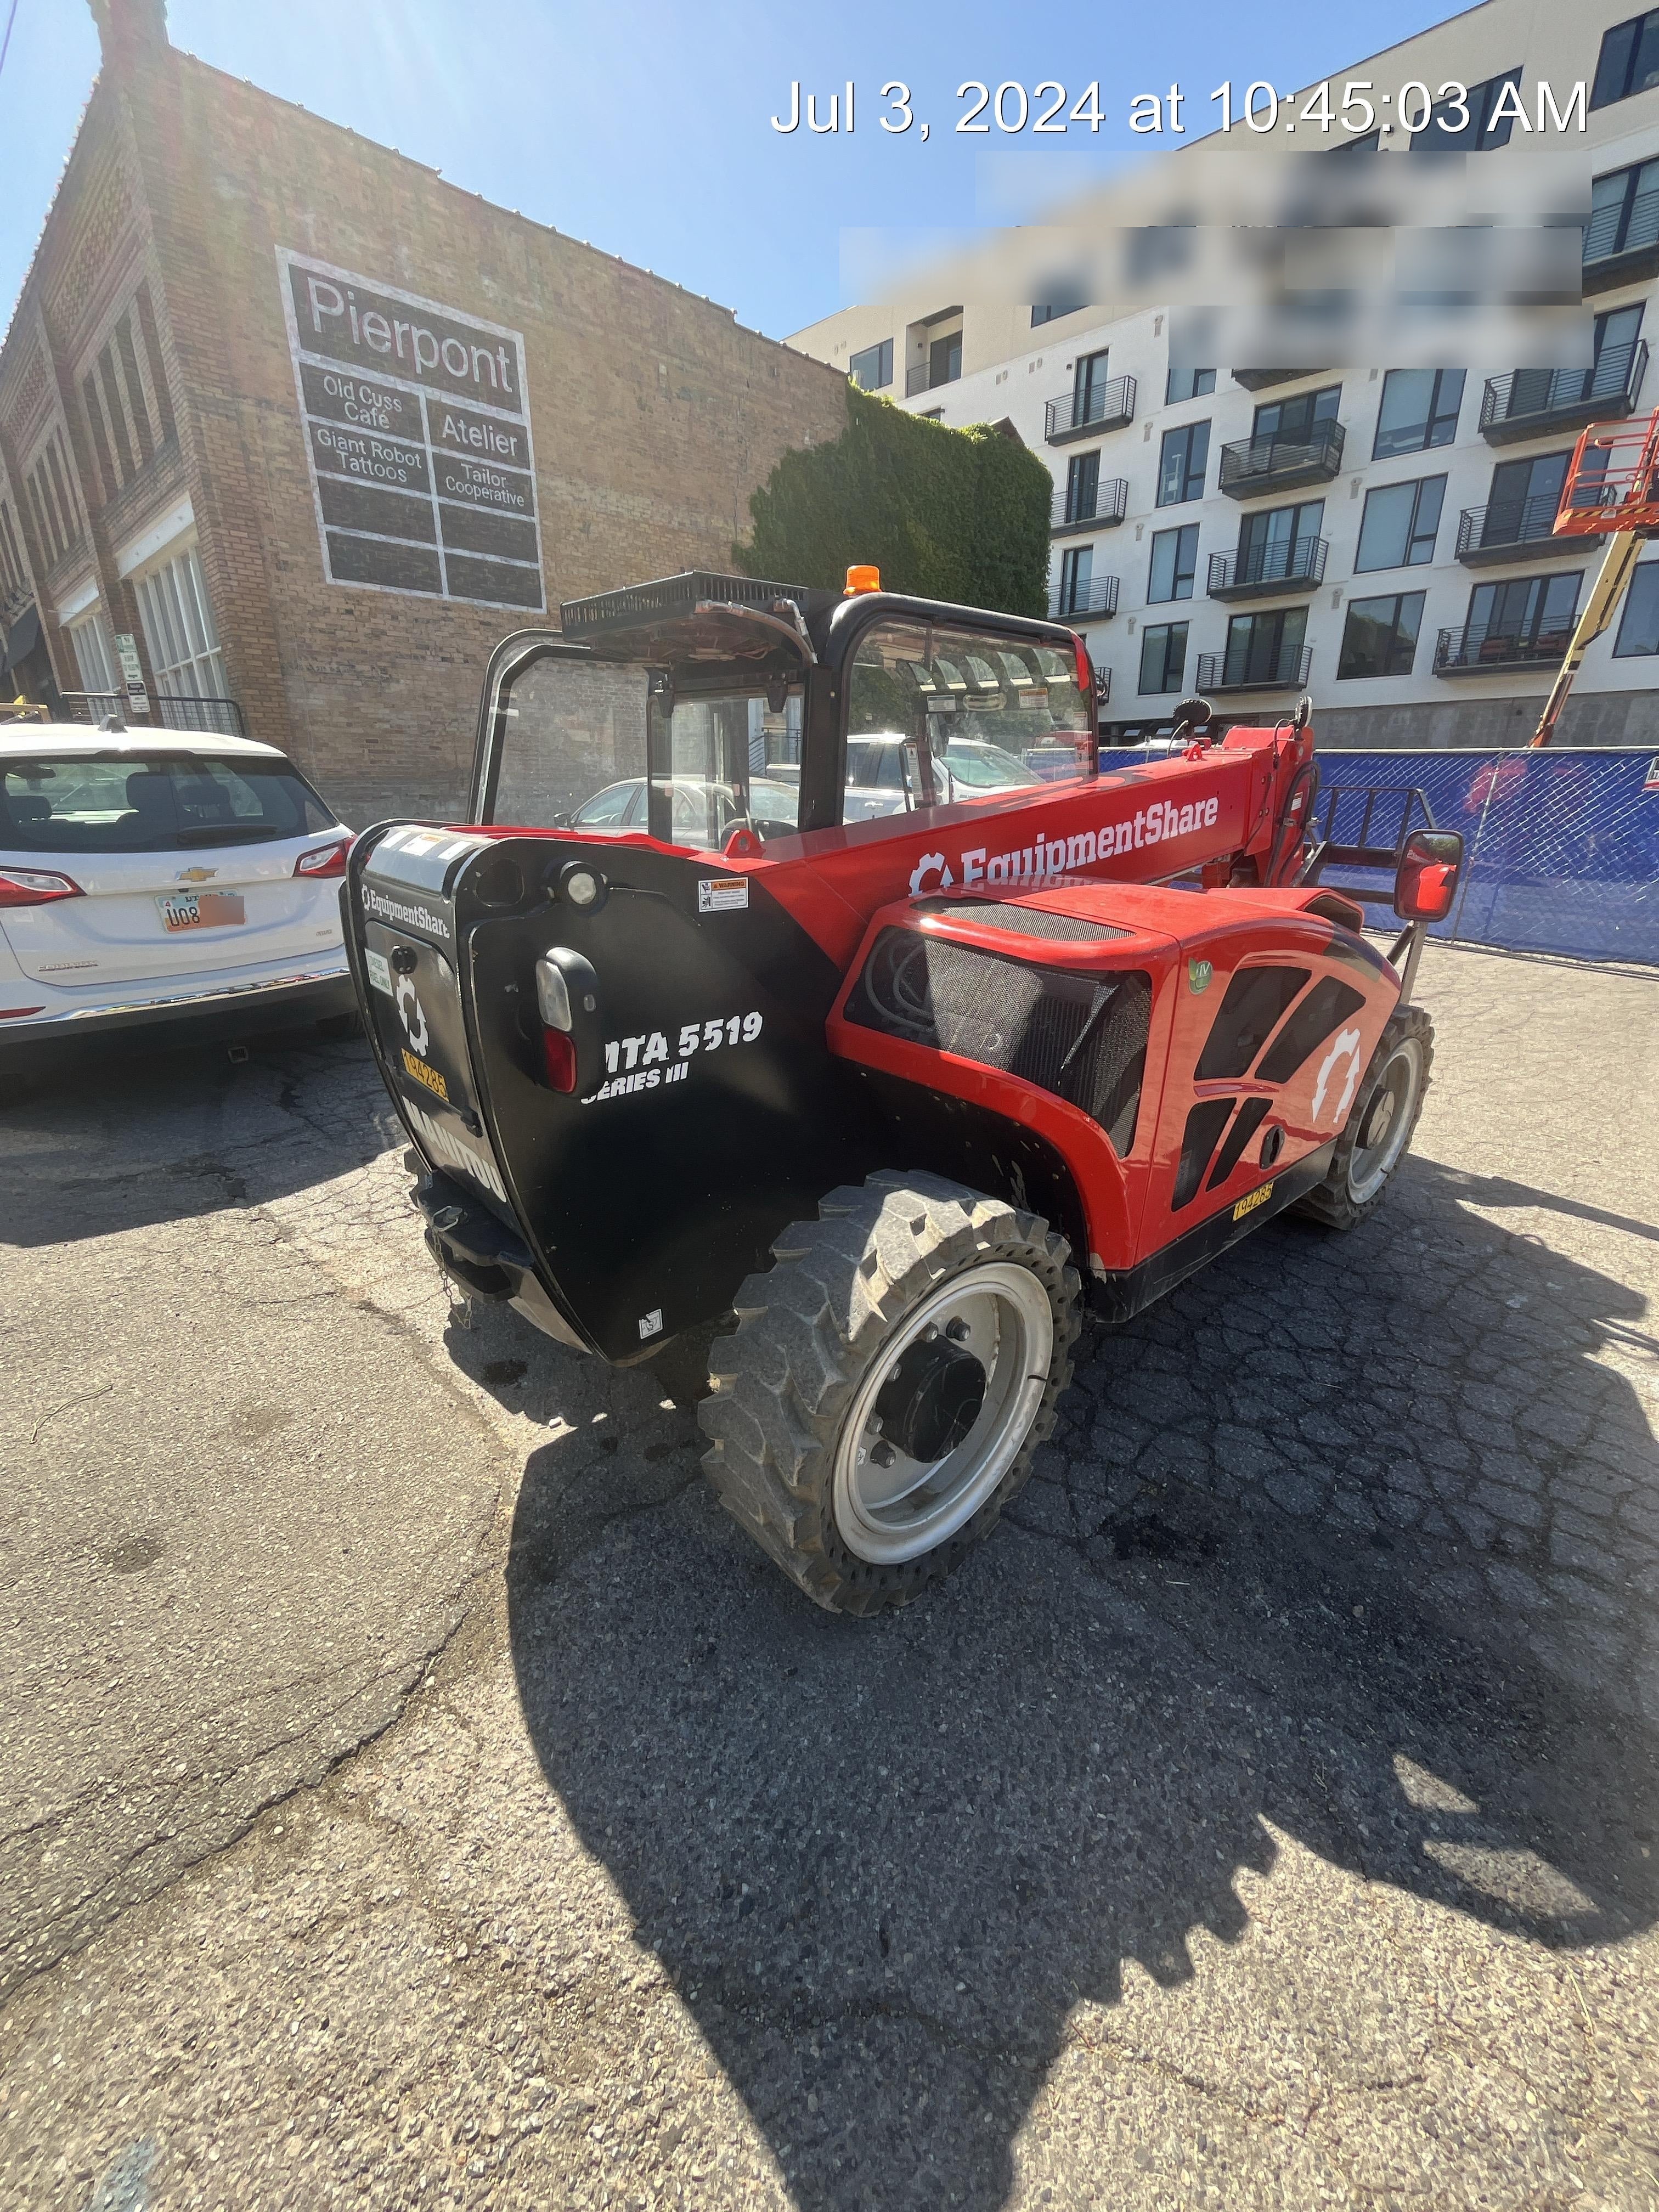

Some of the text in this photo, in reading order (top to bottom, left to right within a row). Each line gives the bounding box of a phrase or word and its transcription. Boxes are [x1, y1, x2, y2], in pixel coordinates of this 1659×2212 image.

[307, 276, 513, 393] Pierpont
[323, 375, 403, 412] Old Cuss
[344, 401, 390, 430] Café
[442, 414, 518, 456] Atelier
[317, 428, 422, 469] Giant Robot
[336, 449, 407, 483] Tattoos
[445, 475, 524, 507] Cooperative
[460, 462, 506, 488] Tailor
[961, 796, 1219, 885] EquipmentShare
[678, 1011, 764, 1057] 5519
[404, 1051, 447, 1098] 194285
[665, 1061, 690, 1084] III
[402, 1095, 507, 1203] MANITOU
[1235, 1183, 1273, 1219] 194285
